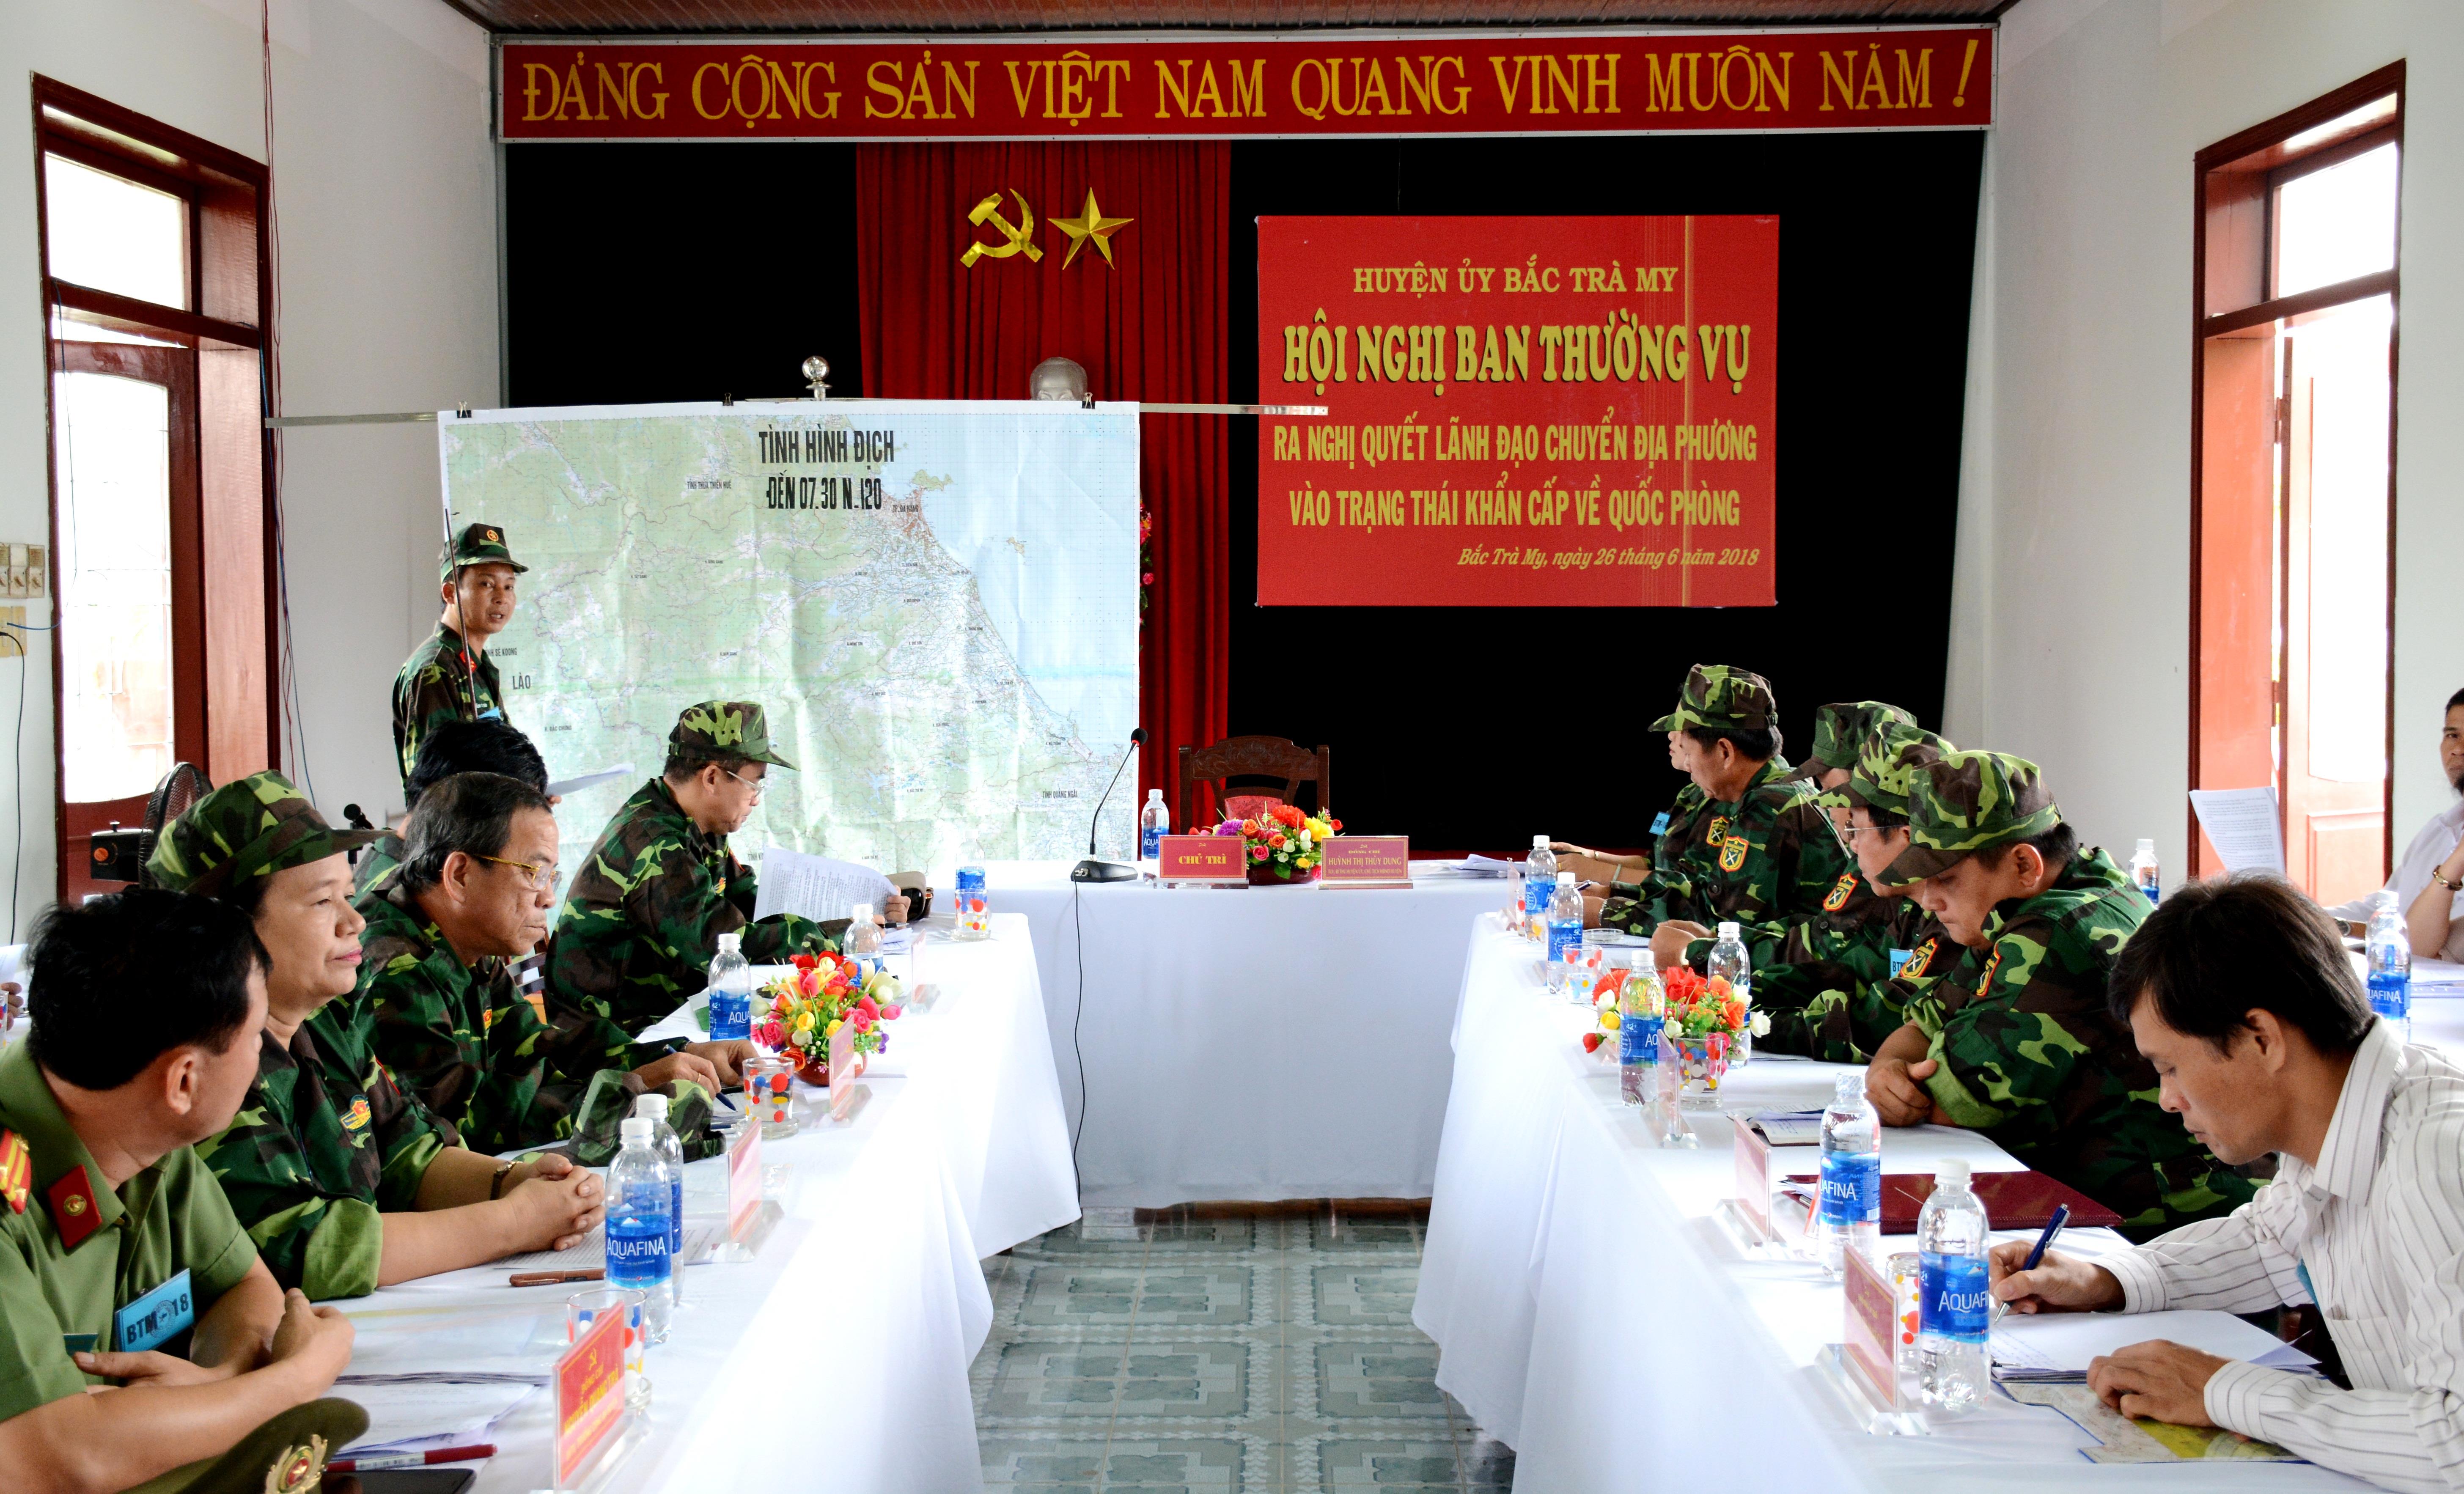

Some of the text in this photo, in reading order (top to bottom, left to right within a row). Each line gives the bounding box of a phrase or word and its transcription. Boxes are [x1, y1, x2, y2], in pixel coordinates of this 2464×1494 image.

[522, 52, 670, 121] ĐẢNG
[692, 55, 842, 128] CỘNG
[865, 50, 980, 119] SẢN
[1003, 50, 1130, 126] VIỆT
[1154, 59, 1266, 118] NAM
[1291, 56, 1472, 121] QUANG
[1489, 54, 1621, 114] VINH
[1645, 45, 1794, 112] MUÔN
[1820, 44, 1933, 111] NĂM
[1353, 254, 1678, 299] HUYỆN ỦY BẮC TRÀ MY
[1283, 308, 1751, 396] HỘI NGHỊ BAN THƯỜNG VỤ
[759, 423, 894, 470] TÌNH HÌNH ĐỊCH
[1274, 406, 1757, 470] RA NGHỊ QUYẾT LÃNH ĐẠO CHUYỂN ĐỊA PHƯƠNG
[766, 470, 795, 509] ĐẾN
[800, 477, 837, 510] 07.30
[1289, 471, 1740, 533] VÀO TRẠNG THÁI KHẨN CẤP VỀ QUỐC PHÒNG
[1457, 543, 1761, 570] Bắc Trà My, ngày 26 tháng 6 năm 2018
[512, 672, 531, 690] LÀO
[1178, 853, 1227, 864] CHỦ TRÌ
[1329, 855, 1351, 865] HUỲNH
[1353, 857, 1363, 867] THỊ
[1383, 857, 1401, 865] DUNG
[607, 1236, 667, 1260] AQUAFINA
